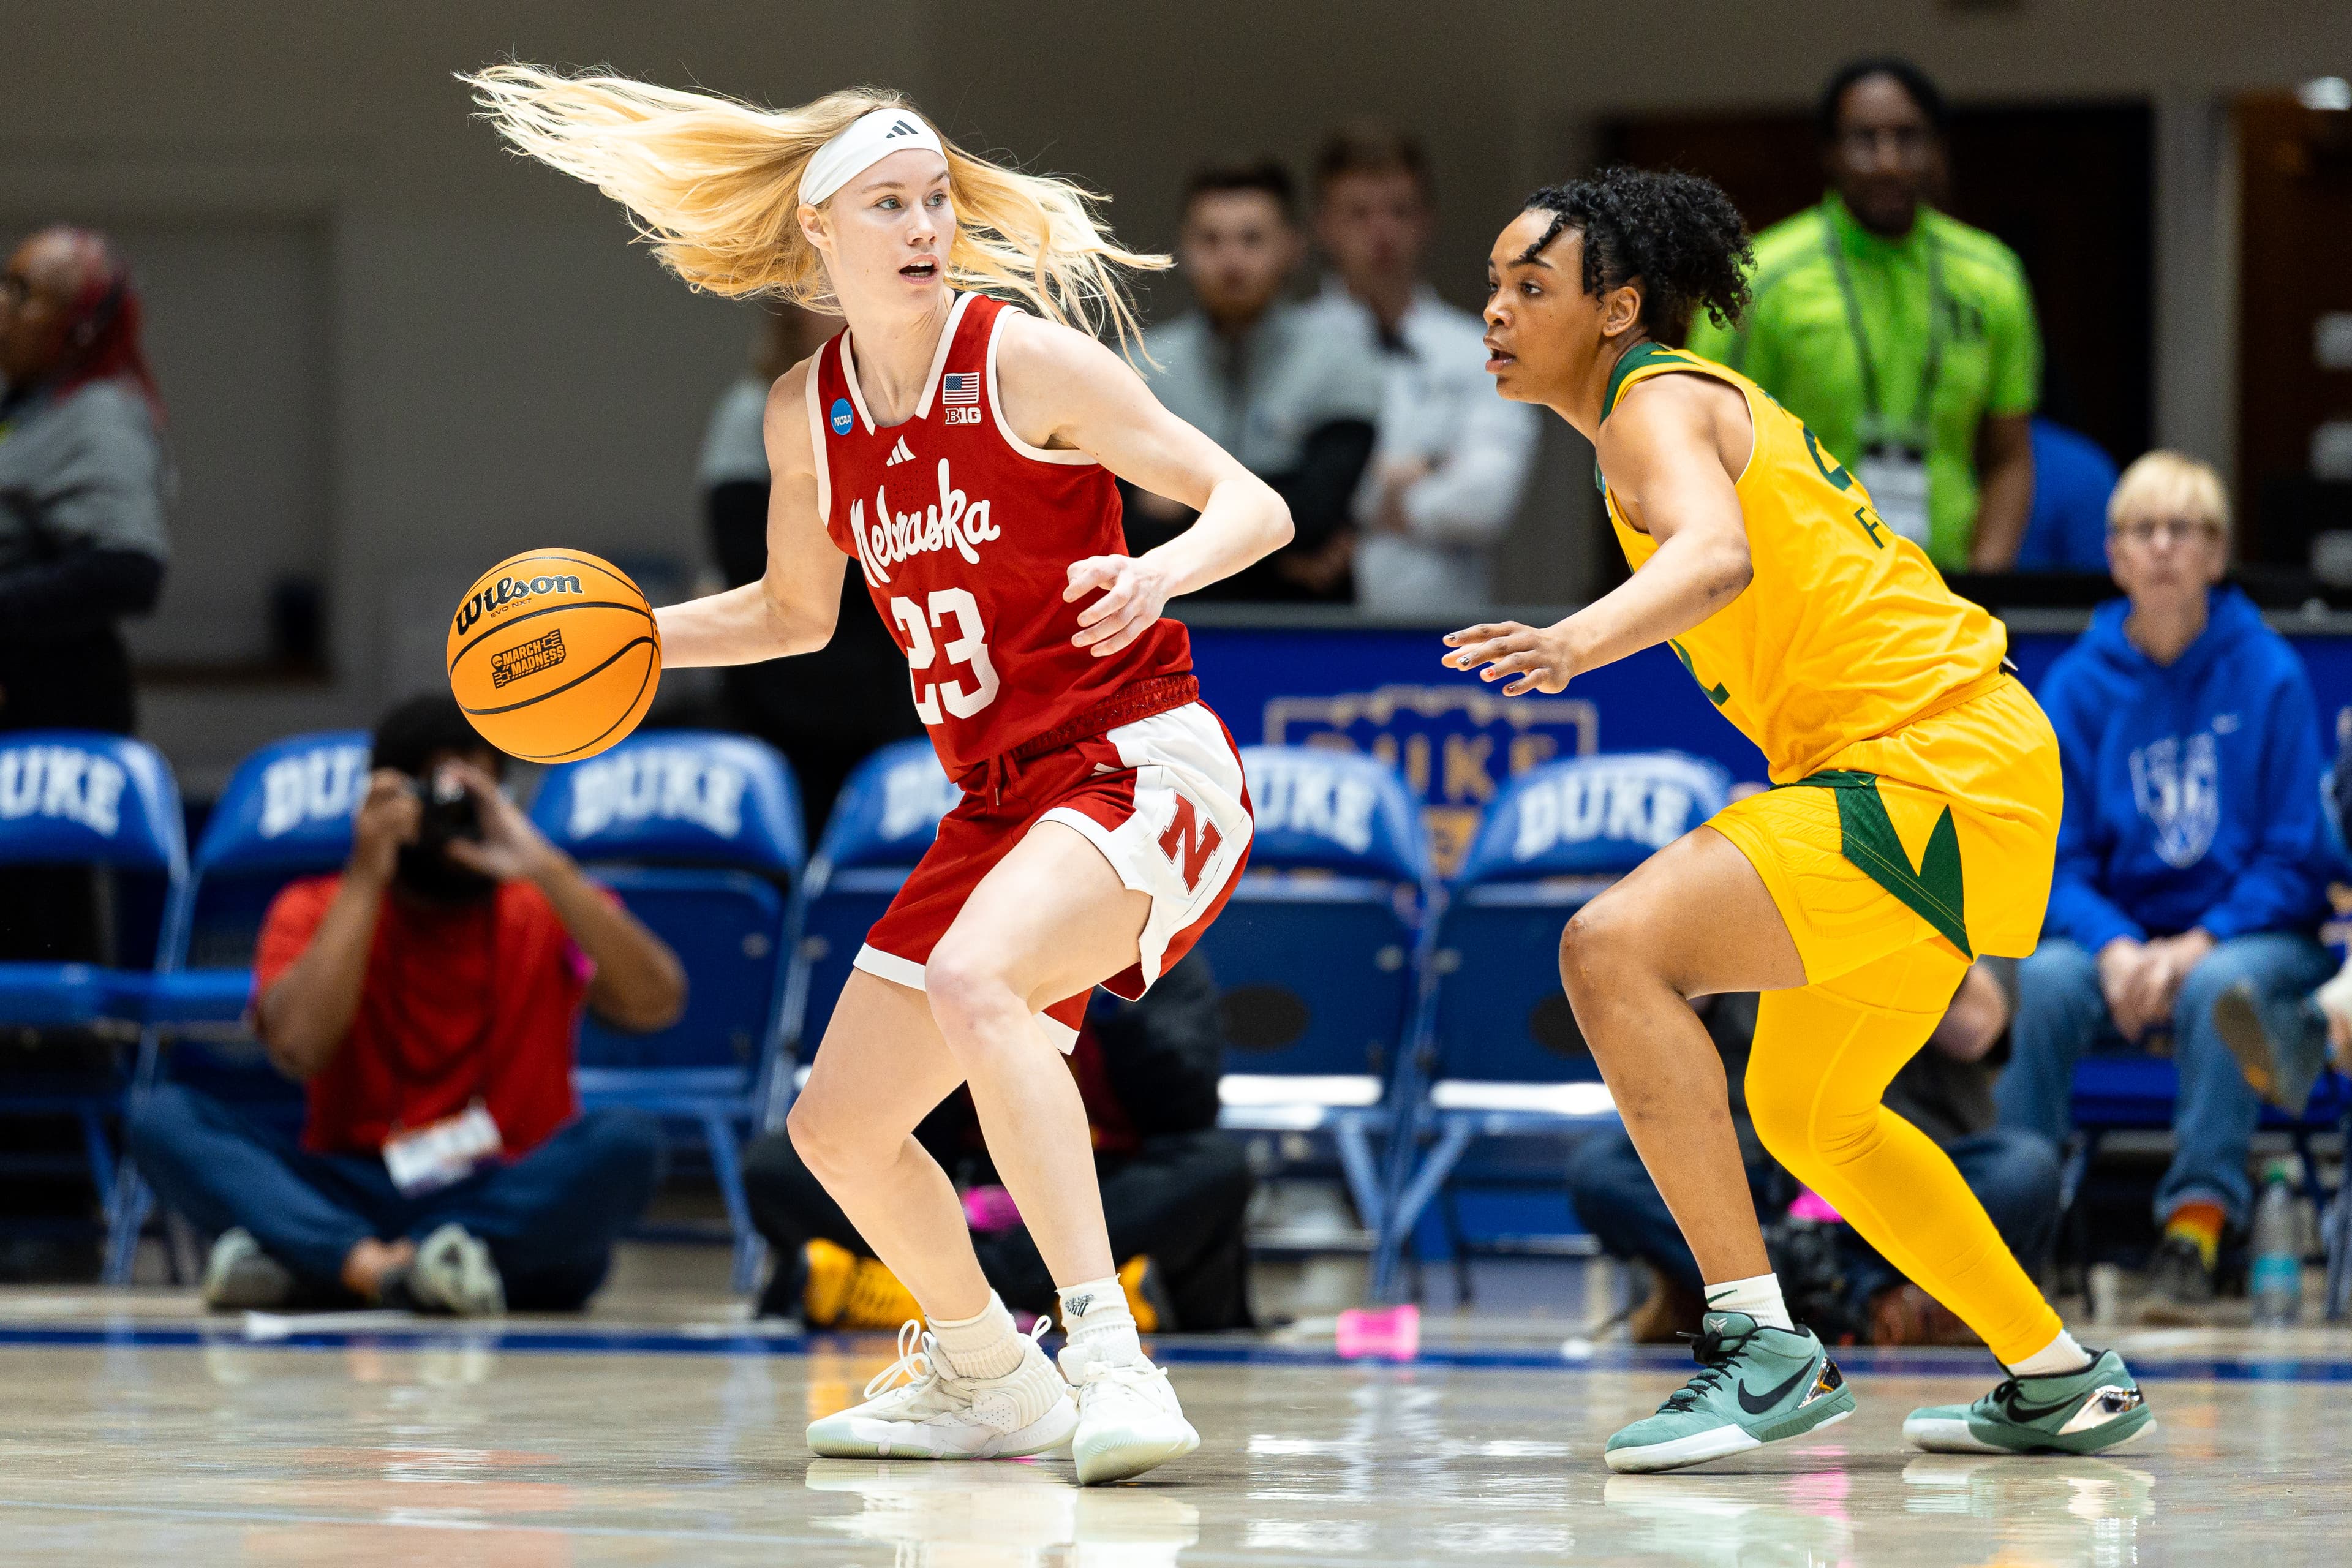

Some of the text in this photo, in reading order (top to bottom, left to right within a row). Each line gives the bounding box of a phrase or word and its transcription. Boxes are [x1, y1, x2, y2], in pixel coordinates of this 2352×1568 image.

[834, 414, 851, 427] NCAA
[850, 458, 1001, 589] Nebraska
[456, 575, 583, 636] Wilson
[490, 598, 532, 618] EVO NXT
[502, 640, 542, 666] MARCH
[511, 644, 565, 675] MADNESS
[891, 587, 1000, 725] 23
[0, 747, 125, 839] UKE
[1158, 791, 1224, 895] N
